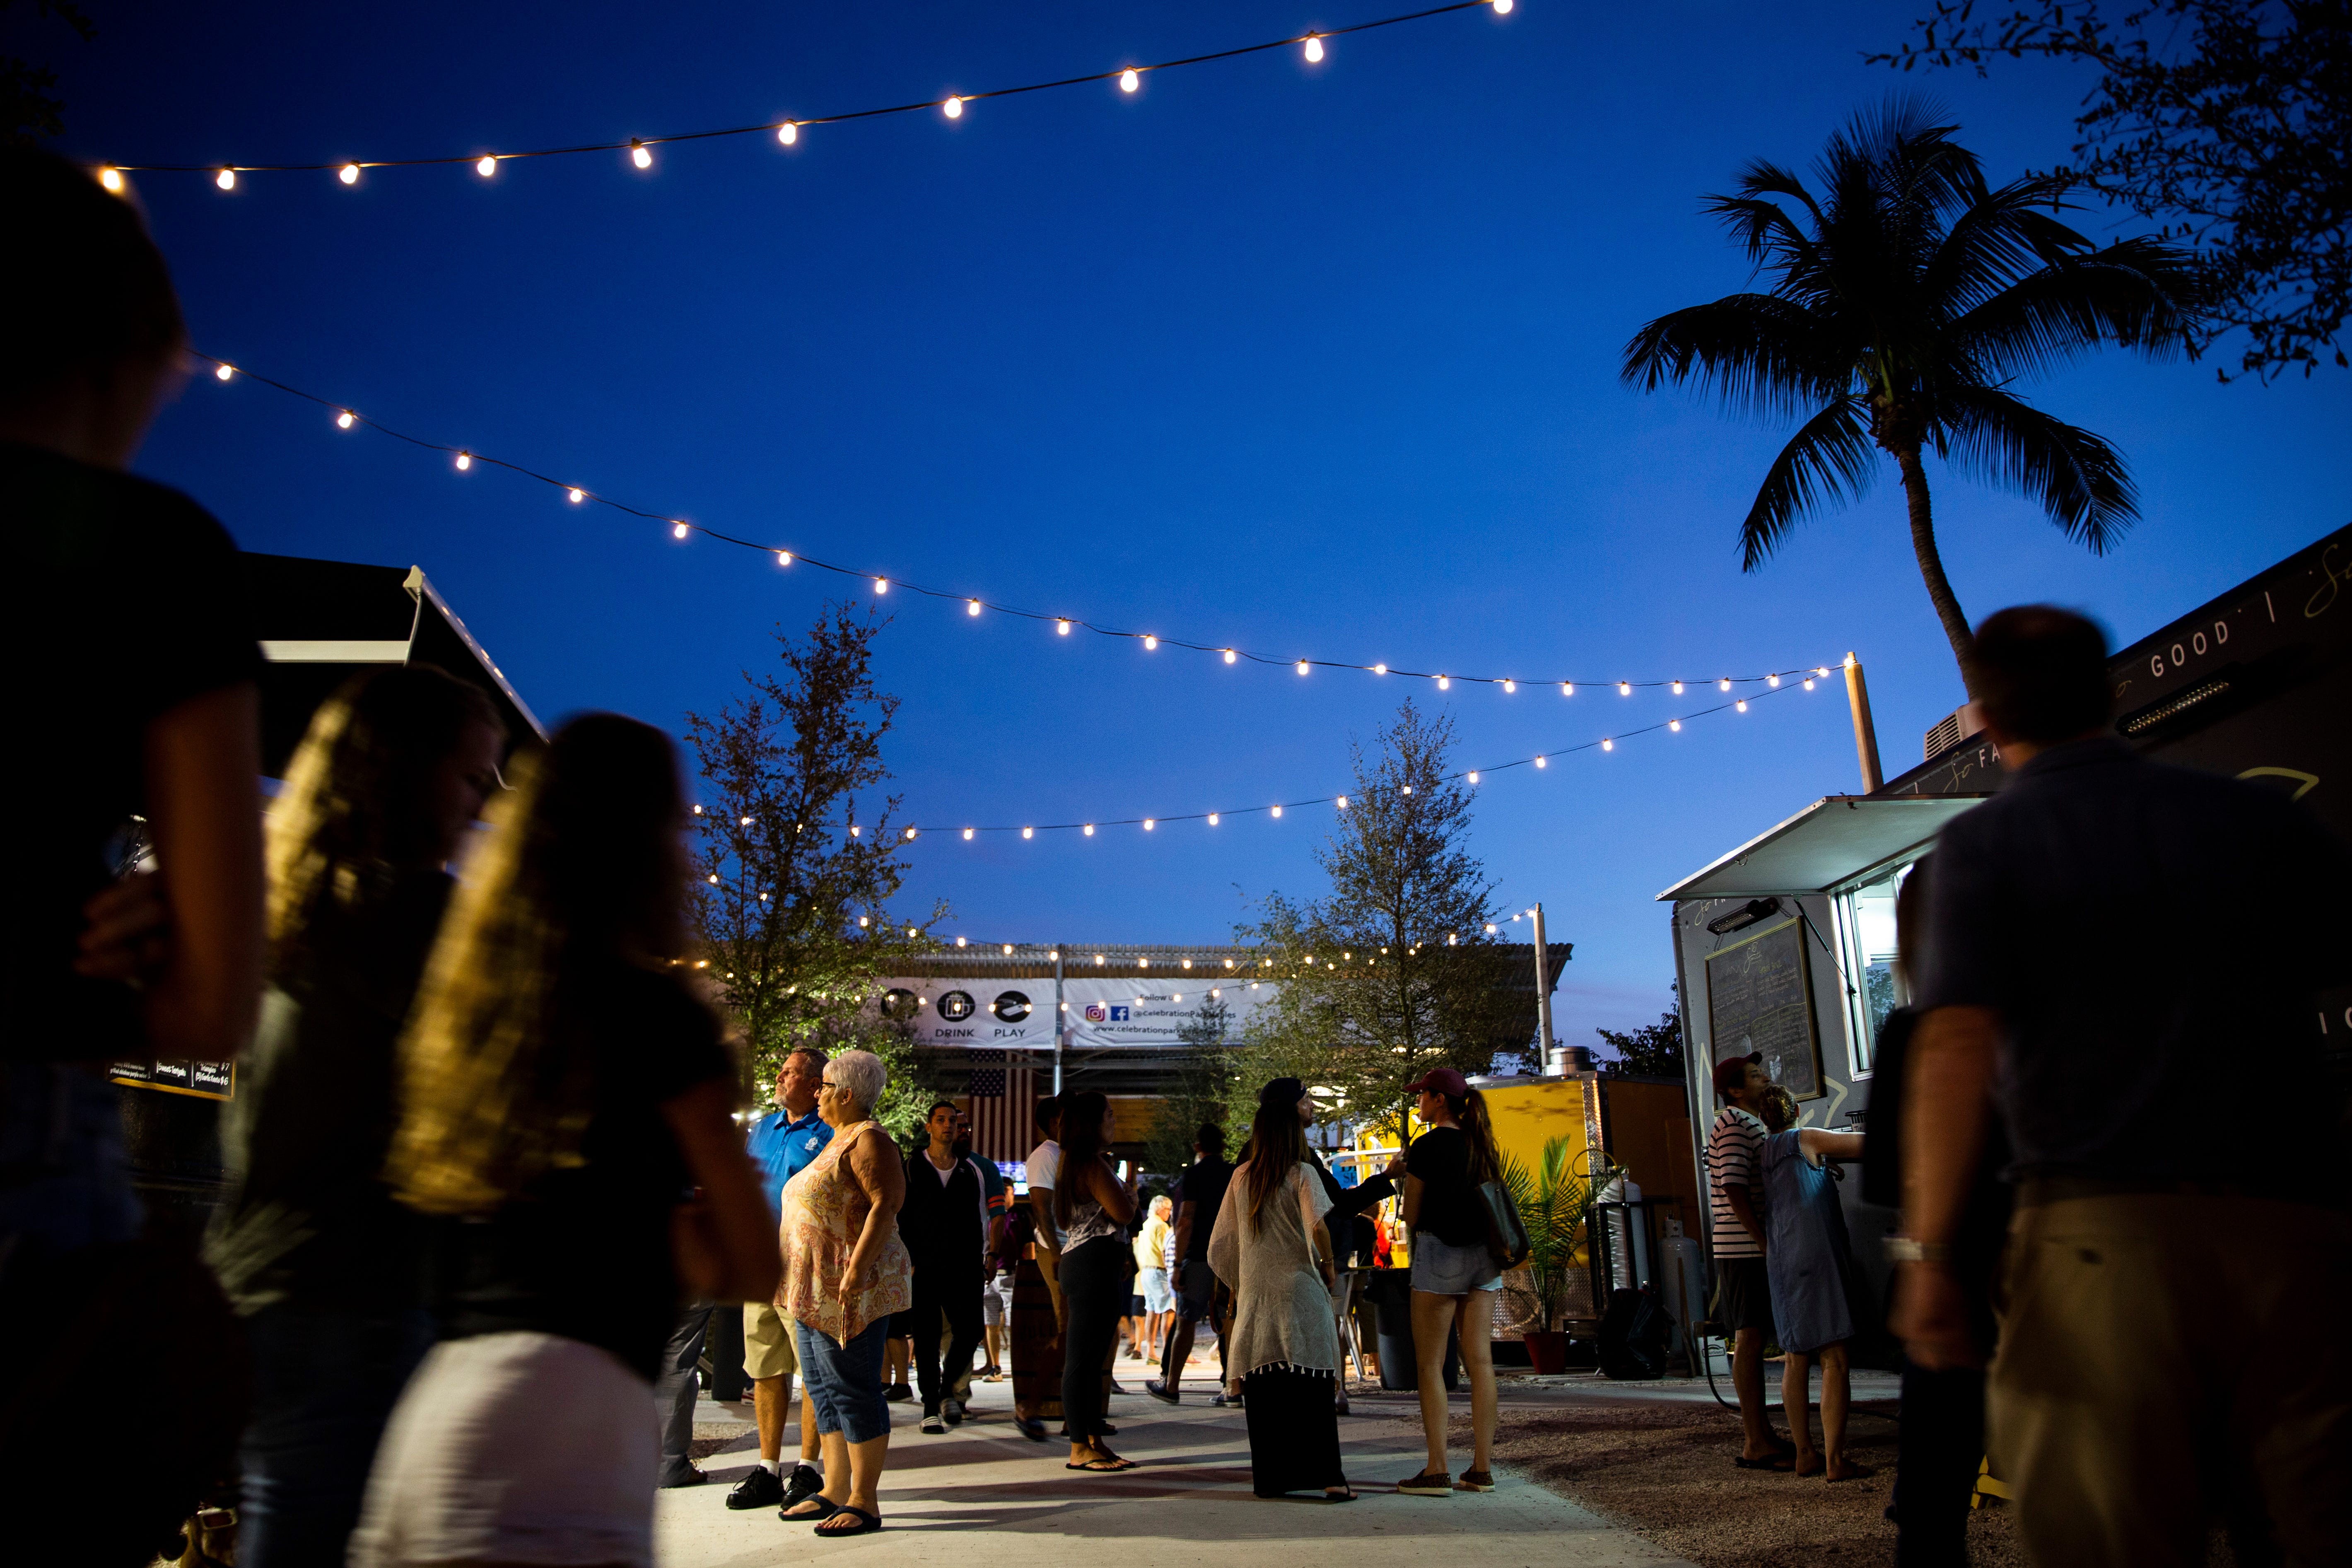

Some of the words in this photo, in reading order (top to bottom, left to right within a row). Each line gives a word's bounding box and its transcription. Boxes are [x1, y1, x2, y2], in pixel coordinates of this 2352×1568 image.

[2151, 621, 2229, 678] GOOD
[1978, 742, 2001, 768] FA
[935, 1028, 974, 1037] DRINK
[994, 1029, 1025, 1037] PLAY
[220, 1076, 229, 1086] $6
